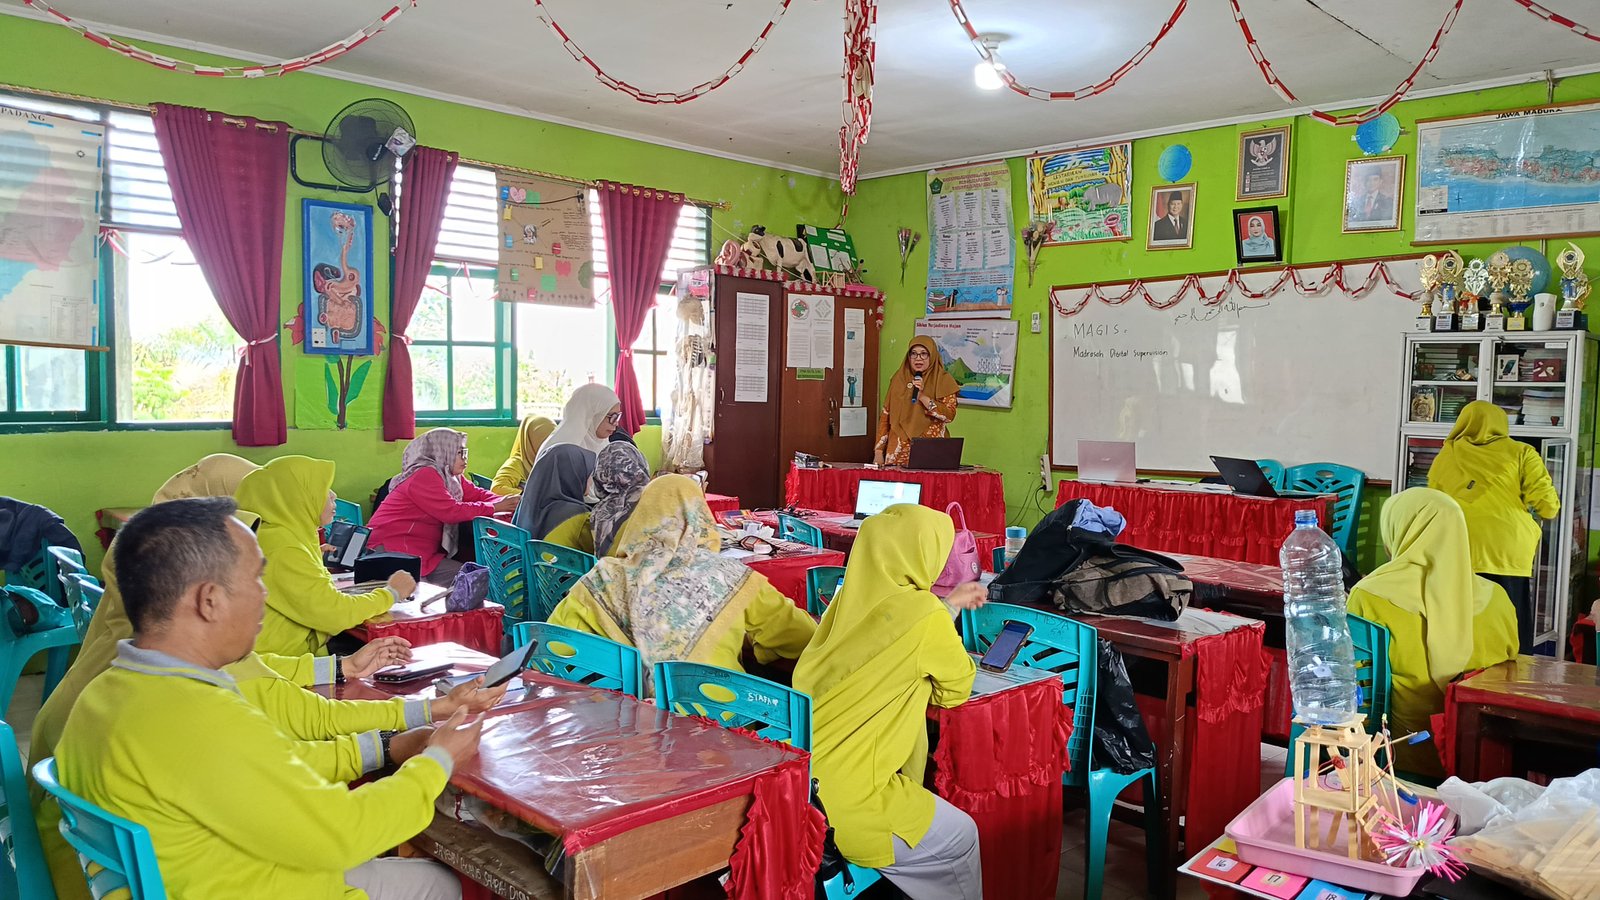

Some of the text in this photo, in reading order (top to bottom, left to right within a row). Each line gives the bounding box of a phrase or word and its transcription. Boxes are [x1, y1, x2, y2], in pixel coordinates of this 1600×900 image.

[1, 107, 45, 121] PADANG
[1496, 111, 1520, 119] JAWA
[1133, 349, 1168, 361] Supervision
[1215, 859, 1227, 868] 16
[1267, 874, 1281, 883] 17
